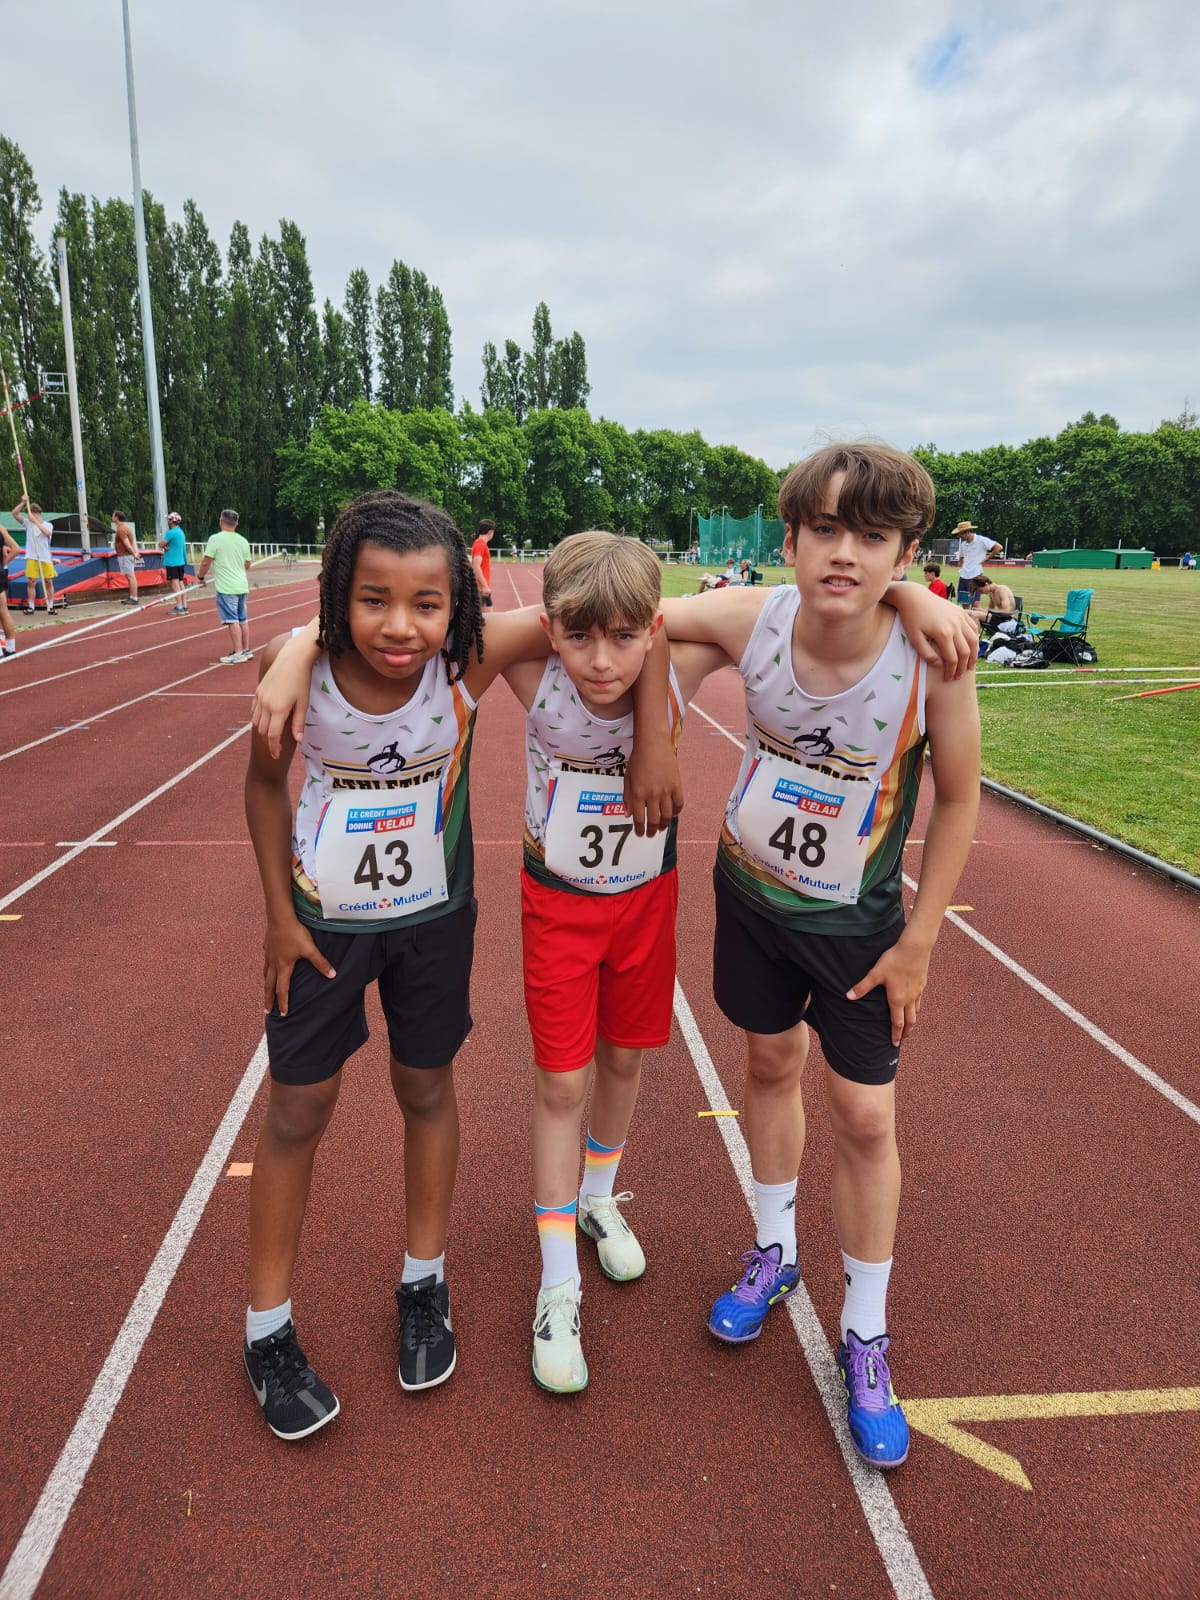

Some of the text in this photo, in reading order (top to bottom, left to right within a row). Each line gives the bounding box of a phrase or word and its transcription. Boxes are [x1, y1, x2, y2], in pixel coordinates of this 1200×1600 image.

[774, 791, 838, 816] DONNE L'ÉLAN
[778, 780, 788, 789] LE
[813, 793, 842, 805] MUTUEL
[349, 811, 359, 819] LE
[579, 803, 626, 814] DONNE L'ÉL
[348, 816, 413, 832] DONNE L'ÉLAN
[579, 823, 633, 869] 37
[768, 816, 827, 868] 48
[354, 839, 413, 892] 43
[608, 871, 646, 884] Mutuel
[798, 874, 841, 892] Mutuel
[338, 901, 378, 912] Crédit
[393, 887, 433, 907] Mutuel
